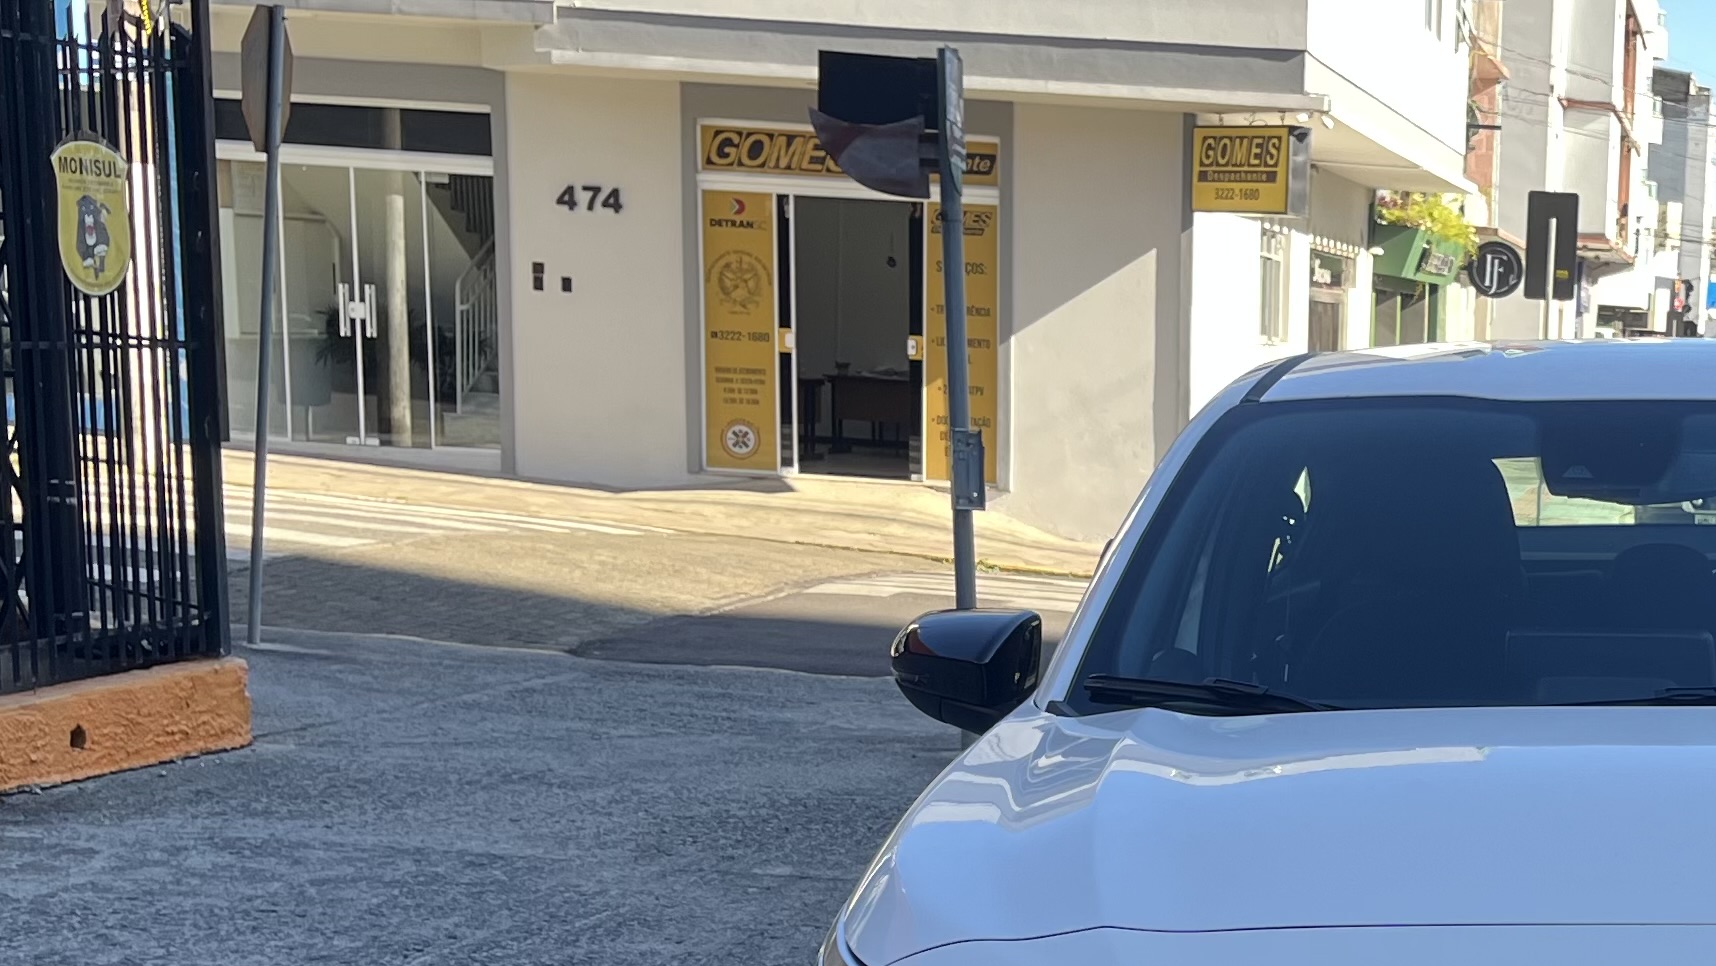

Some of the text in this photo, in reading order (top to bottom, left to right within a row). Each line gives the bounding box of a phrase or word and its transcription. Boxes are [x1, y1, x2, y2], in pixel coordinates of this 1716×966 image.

[1201, 137, 1280, 166] GOMES
[58, 156, 122, 178] MONISUL
[556, 184, 623, 214] 474
[1214, 187, 1260, 201] 3222-1680
[935, 260, 988, 276] SÇOS:
[718, 330, 770, 342] 3222-1680
